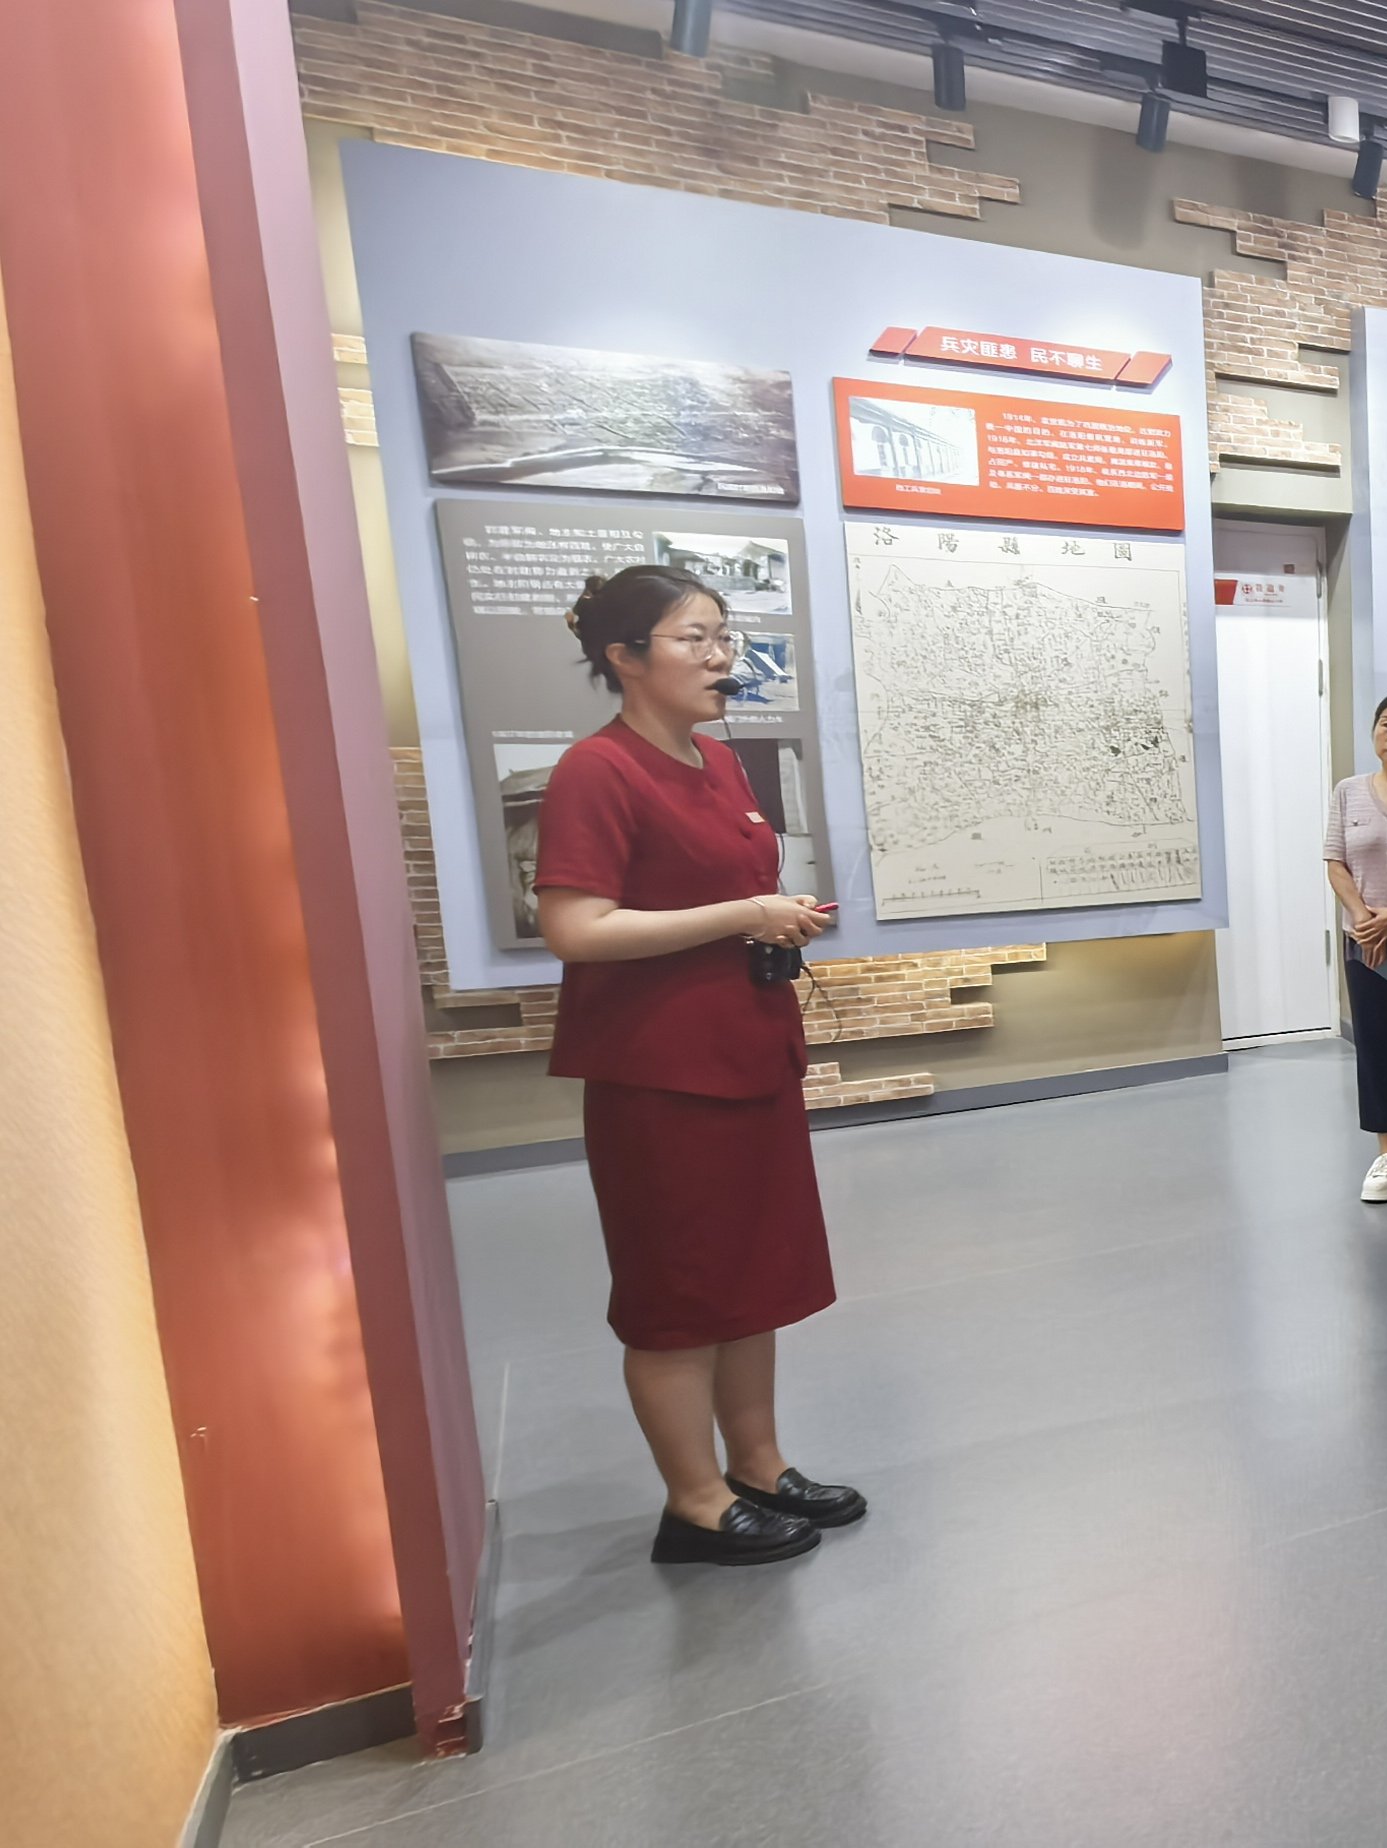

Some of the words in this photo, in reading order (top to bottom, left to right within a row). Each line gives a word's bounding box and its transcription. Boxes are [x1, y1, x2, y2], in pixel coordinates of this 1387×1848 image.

[940, 335, 1018, 360] 兵灾匪患
[1030, 346, 1104, 371] 民不聊生
